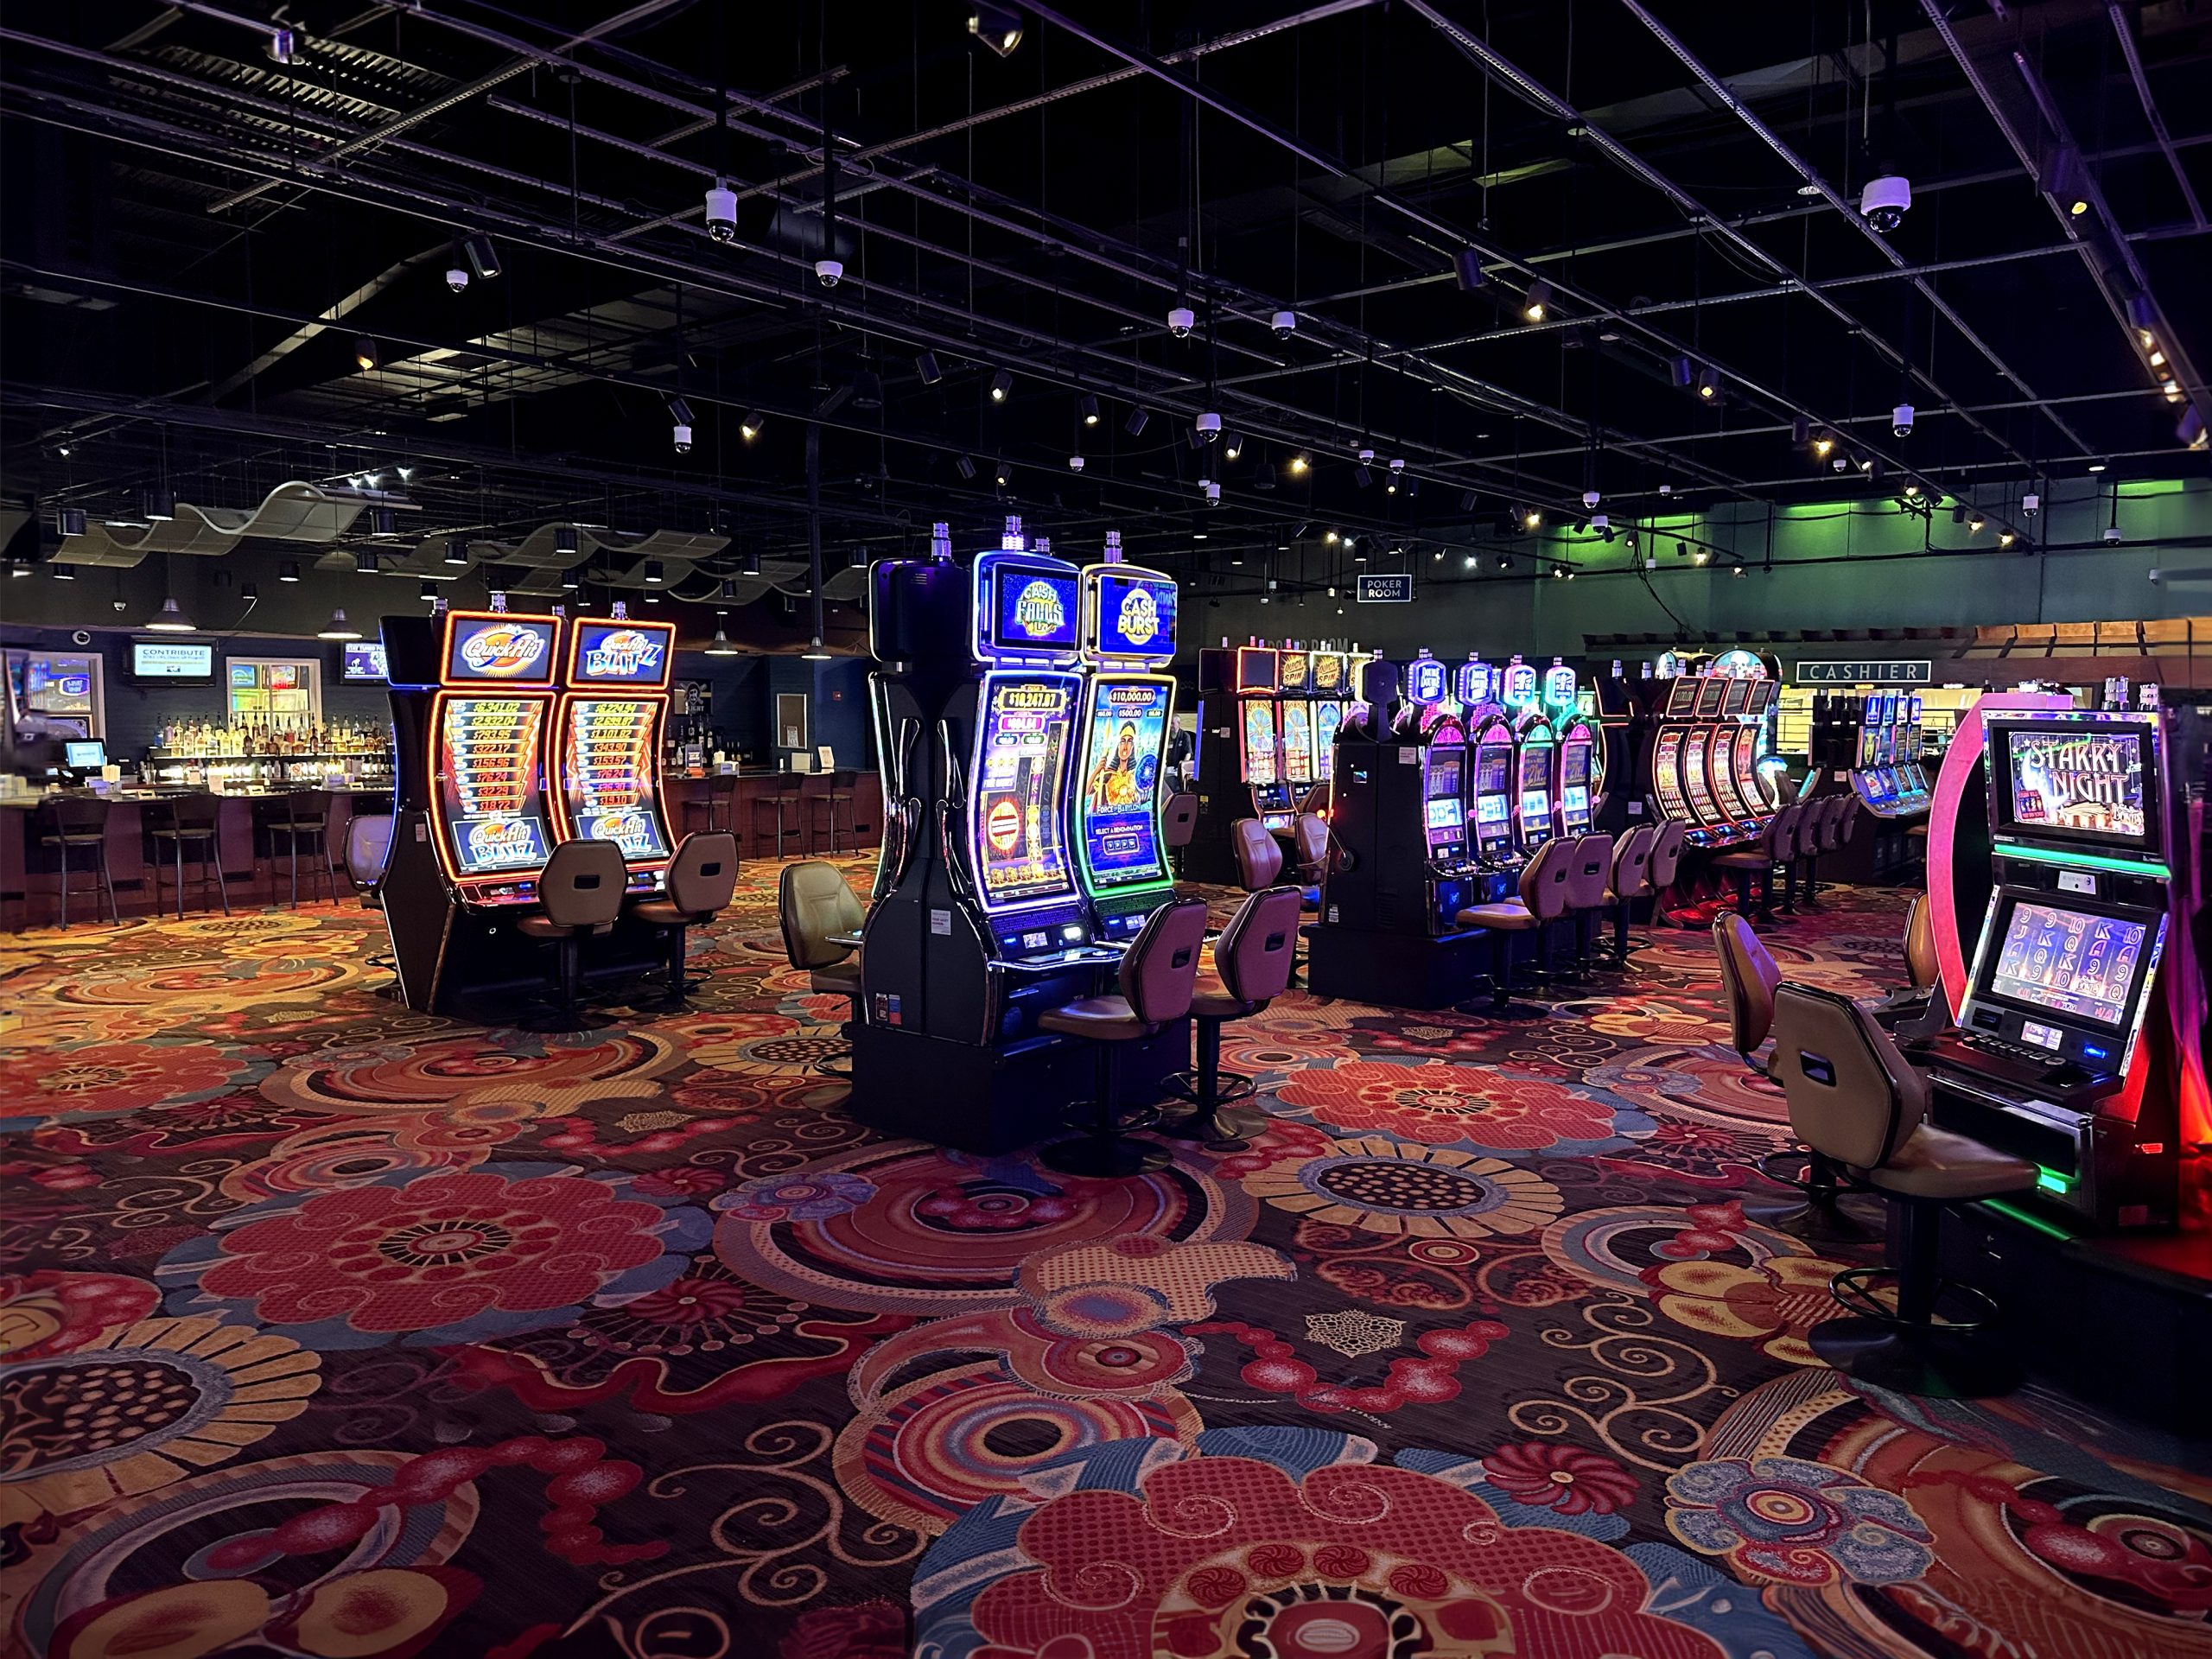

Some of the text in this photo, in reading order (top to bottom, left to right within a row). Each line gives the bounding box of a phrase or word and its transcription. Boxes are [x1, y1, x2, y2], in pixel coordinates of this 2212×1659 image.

[1367, 580, 1402, 588] POKER
[1023, 585, 1057, 601] CASH
[1368, 588, 1401, 598] ROOM
[1016, 599, 1064, 625] FALLS
[1122, 598, 1157, 616] CASH
[1116, 614, 1160, 636] BURST
[466, 637, 539, 658] Quick Hit
[602, 638, 629, 651] Quick
[586, 643, 664, 676] BLITZ
[1285, 659, 1302, 673] QUICK
[1284, 672, 1302, 682] SPIN
[1318, 673, 1336, 683] SPIN
[1809, 664, 1917, 679] CASHIER
[1112, 692, 1152, 702] $10,000.00
[474, 730, 512, 740] $793.95
[473, 745, 510, 753] $322.17
[2030, 739, 2125, 773] STARRY
[473, 759, 510, 768] $156.96
[477, 772, 507, 782] $76.24
[478, 786, 508, 797] $32.29
[2051, 769, 2129, 804] NIGHT
[480, 800, 510, 810] $18.72
[1117, 804, 1141, 812] BABYLON
[473, 828, 507, 843] Quick
[469, 840, 537, 866] BLITZ
[2020, 907, 2141, 944] 9 9 10 K 10
[2014, 925, 2135, 963] J K Q A A
[2007, 941, 2128, 981] A Q K 9 9
[2005, 959, 2020, 976] K
[2031, 964, 2042, 981] 9
[2054, 971, 2069, 988] 10
[2109, 985, 2123, 1000] Q
